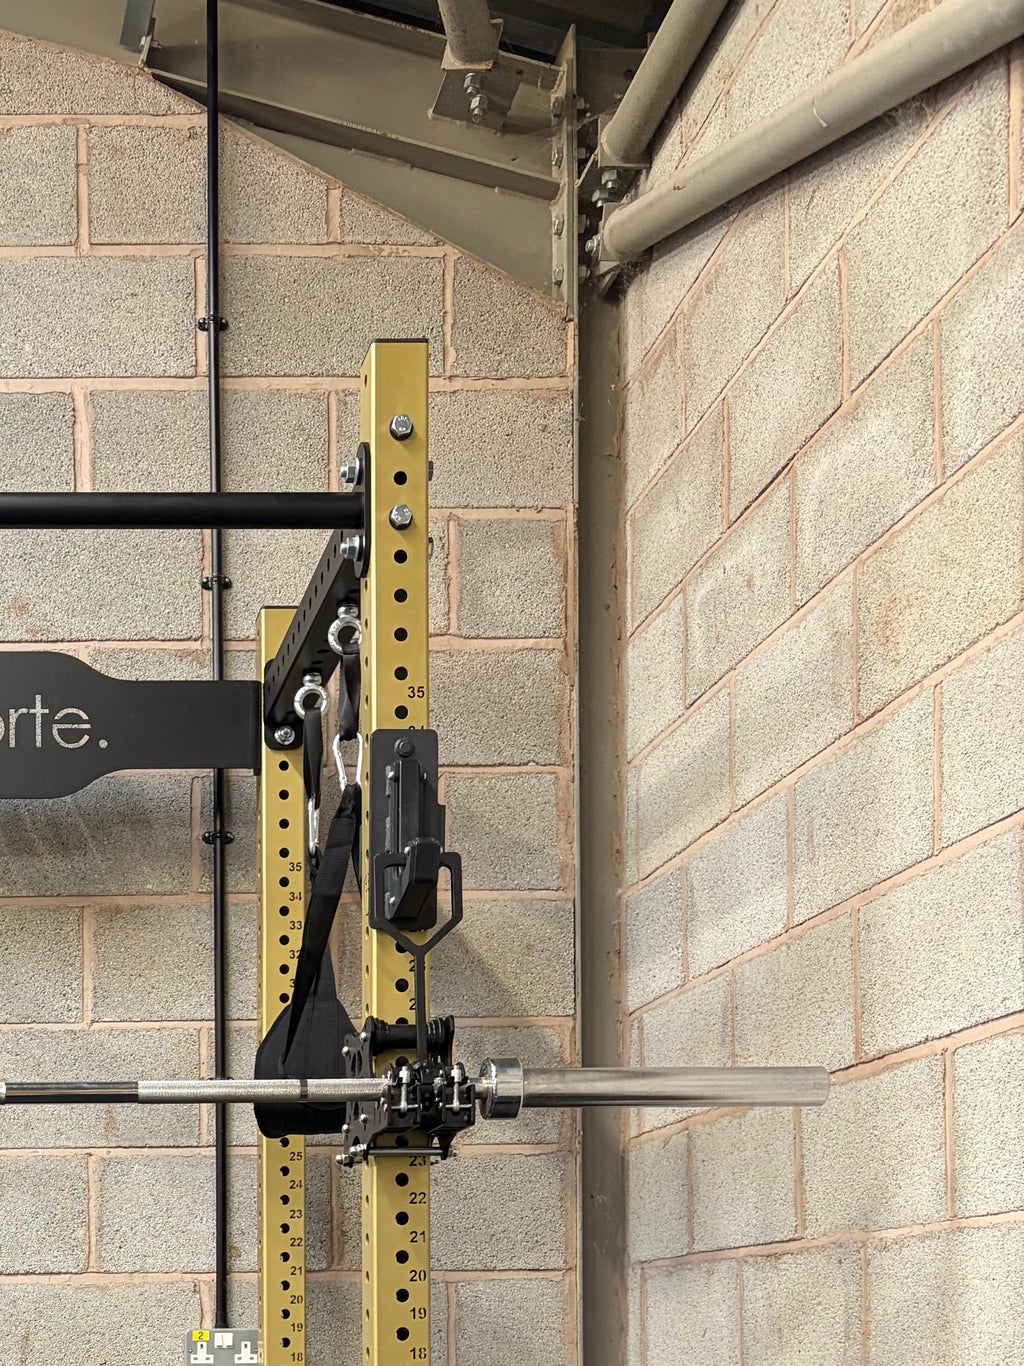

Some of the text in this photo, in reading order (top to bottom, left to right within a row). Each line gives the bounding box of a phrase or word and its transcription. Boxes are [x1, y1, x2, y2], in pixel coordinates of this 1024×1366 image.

[407, 685, 426, 699] 35
[408, 1191, 427, 1205] 22
[409, 1230, 426, 1244] 21
[408, 1269, 427, 1283] 20
[409, 1306, 427, 1320] 19
[198, 1331, 204, 1340] 2
[409, 1346, 428, 1361] 18
